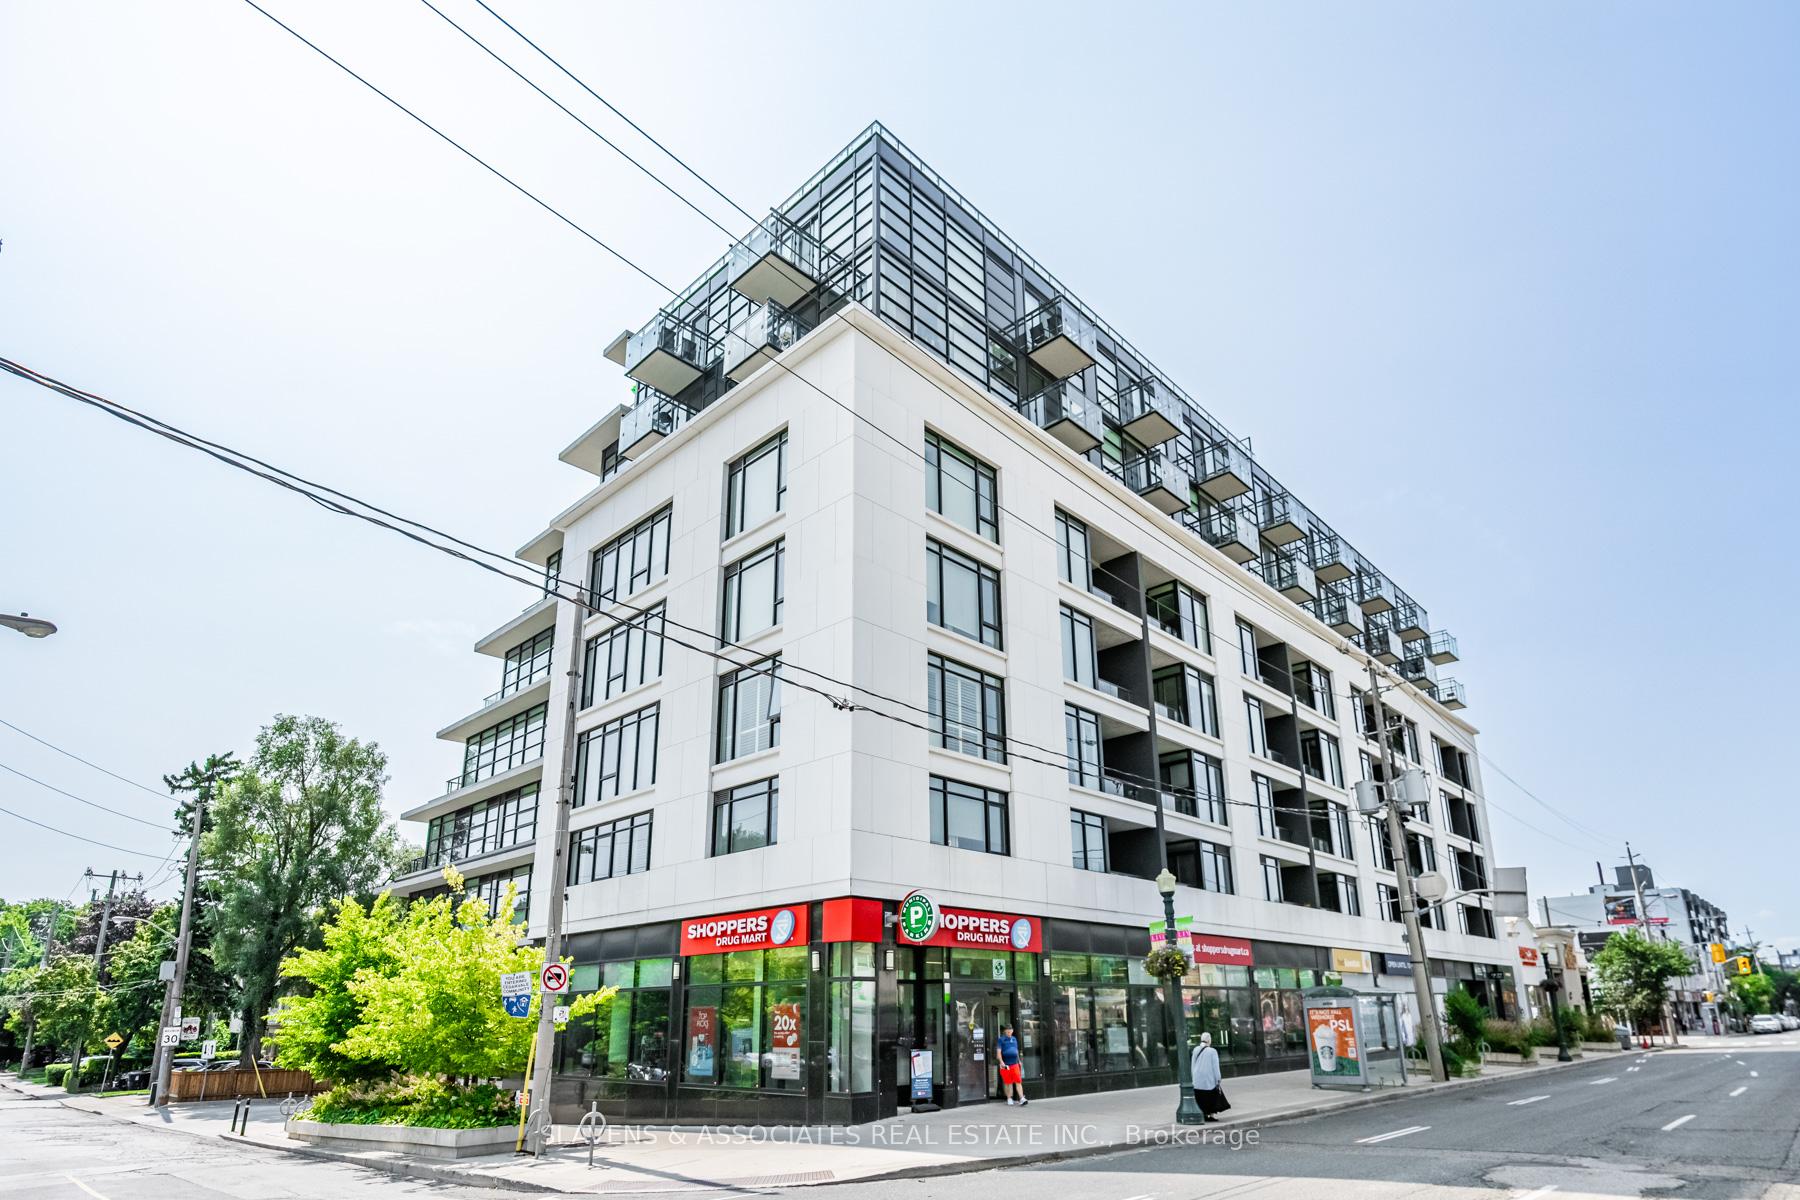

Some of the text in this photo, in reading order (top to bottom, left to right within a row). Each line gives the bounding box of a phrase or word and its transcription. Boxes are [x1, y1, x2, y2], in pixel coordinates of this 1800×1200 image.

[903, 896, 931, 913] MUNICIPAL
[910, 906, 924, 924] P
[687, 915, 768, 939] SHOPPERS
[903, 920, 931, 938] PARKING
[716, 932, 767, 947] DRUG MART
[957, 931, 1010, 945] DRUG MART
[774, 1014, 796, 1031] 20x
[1330, 1018, 1353, 1031] PSL
[163, 1034, 178, 1044] 30
